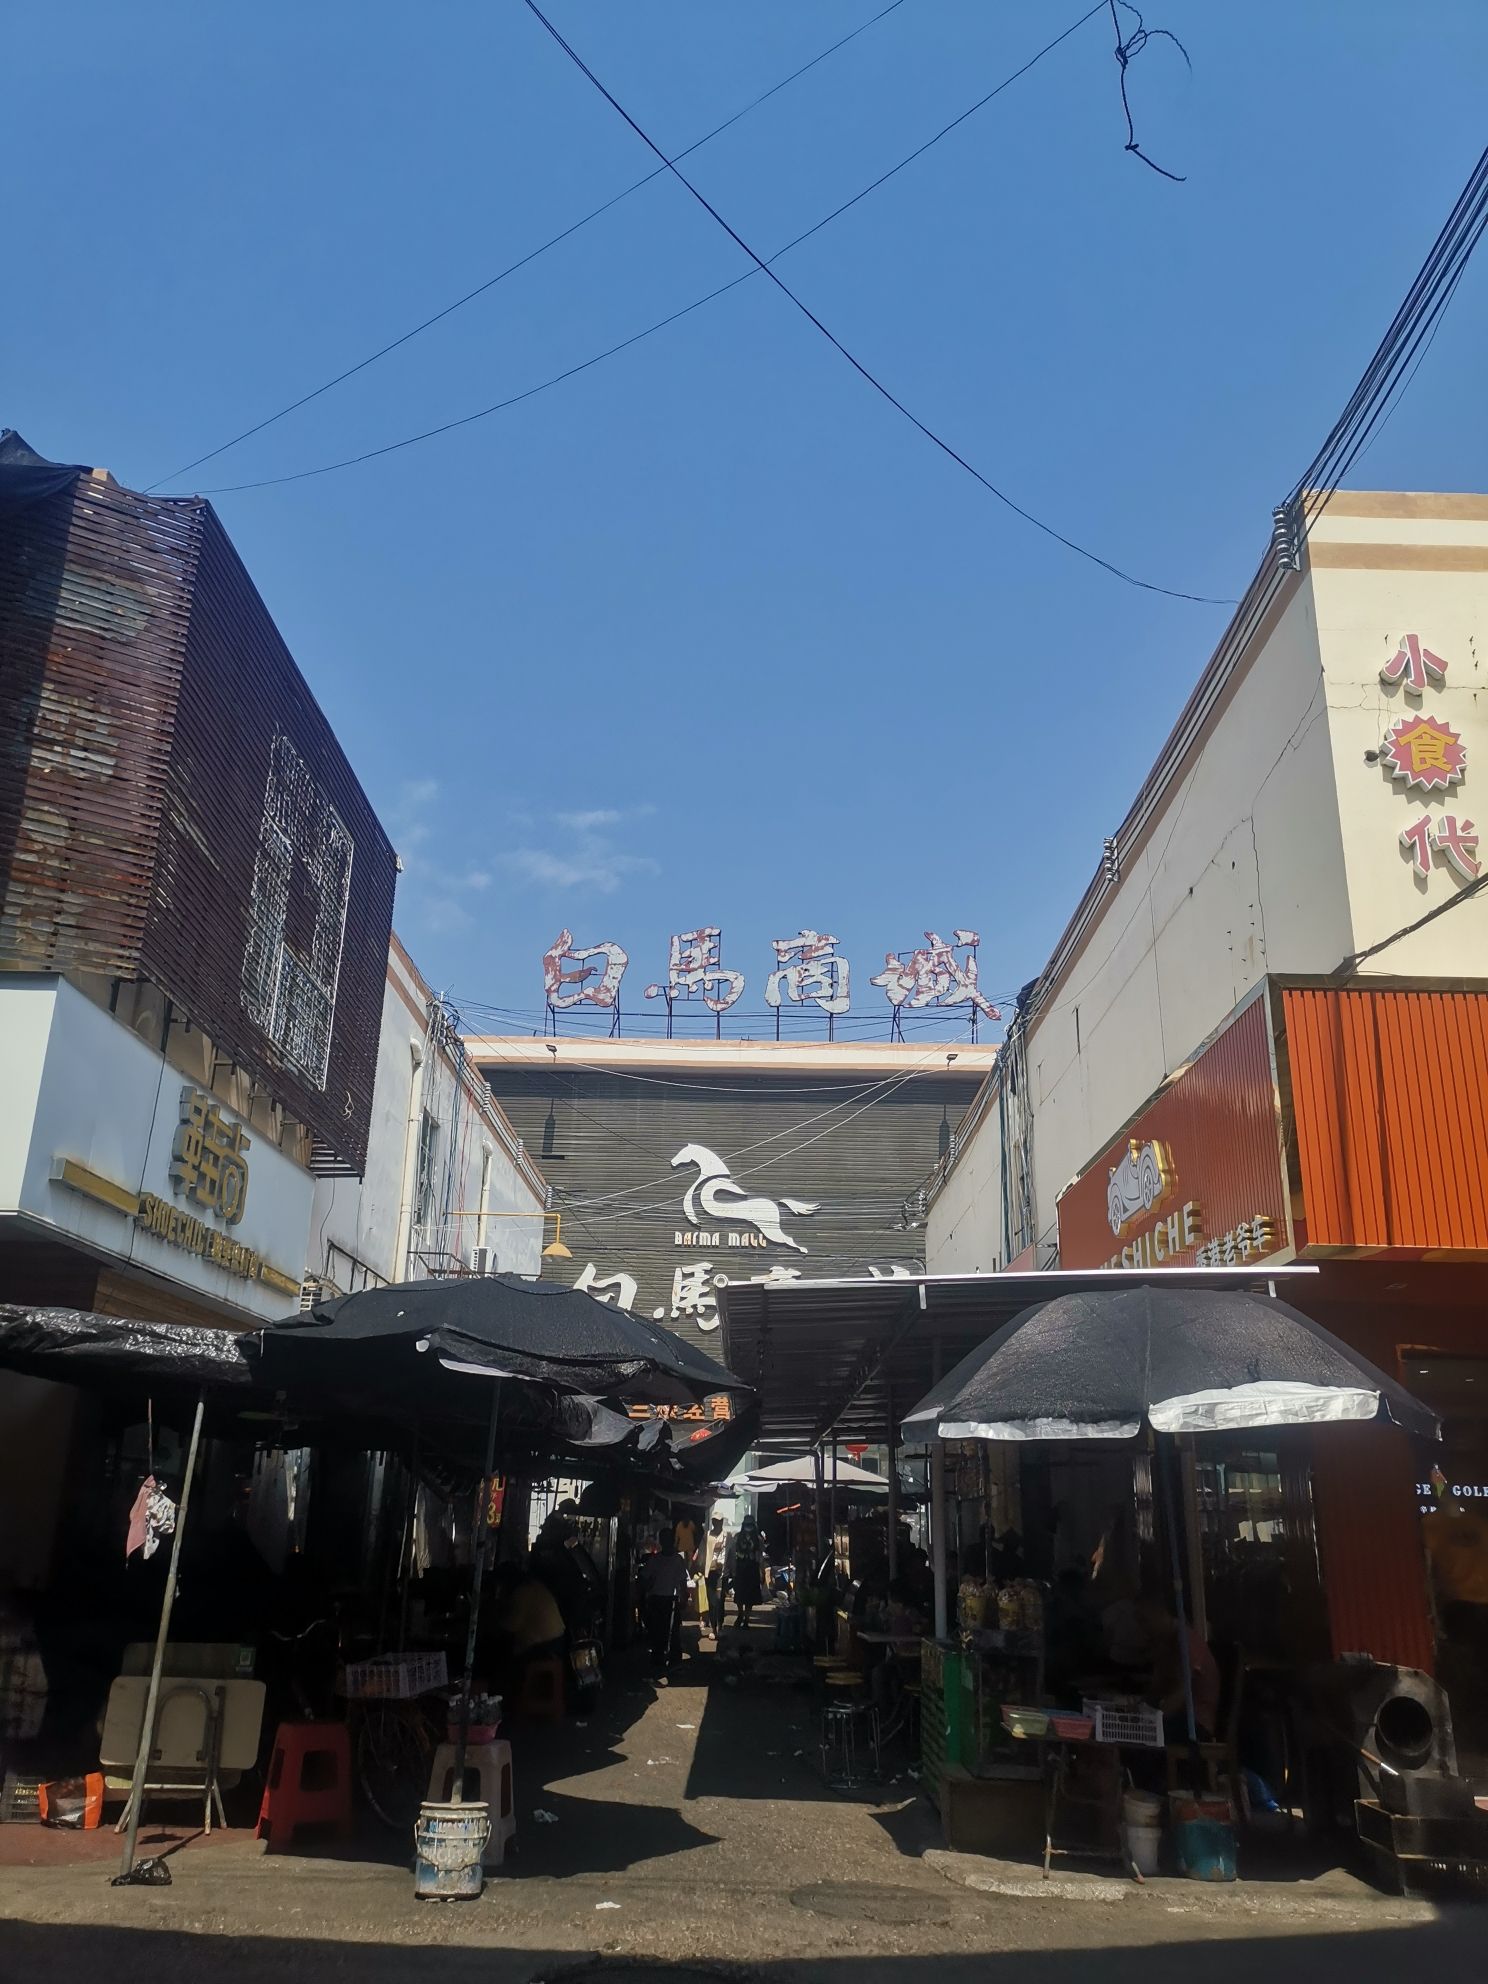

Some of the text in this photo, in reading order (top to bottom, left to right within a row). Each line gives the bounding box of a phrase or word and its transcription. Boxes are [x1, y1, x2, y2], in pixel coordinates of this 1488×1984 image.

[1381, 633, 1482, 880] 小食代
[728, 1231, 767, 1247] MALL
[1101, 1201, 1200, 1268] SHICHE
